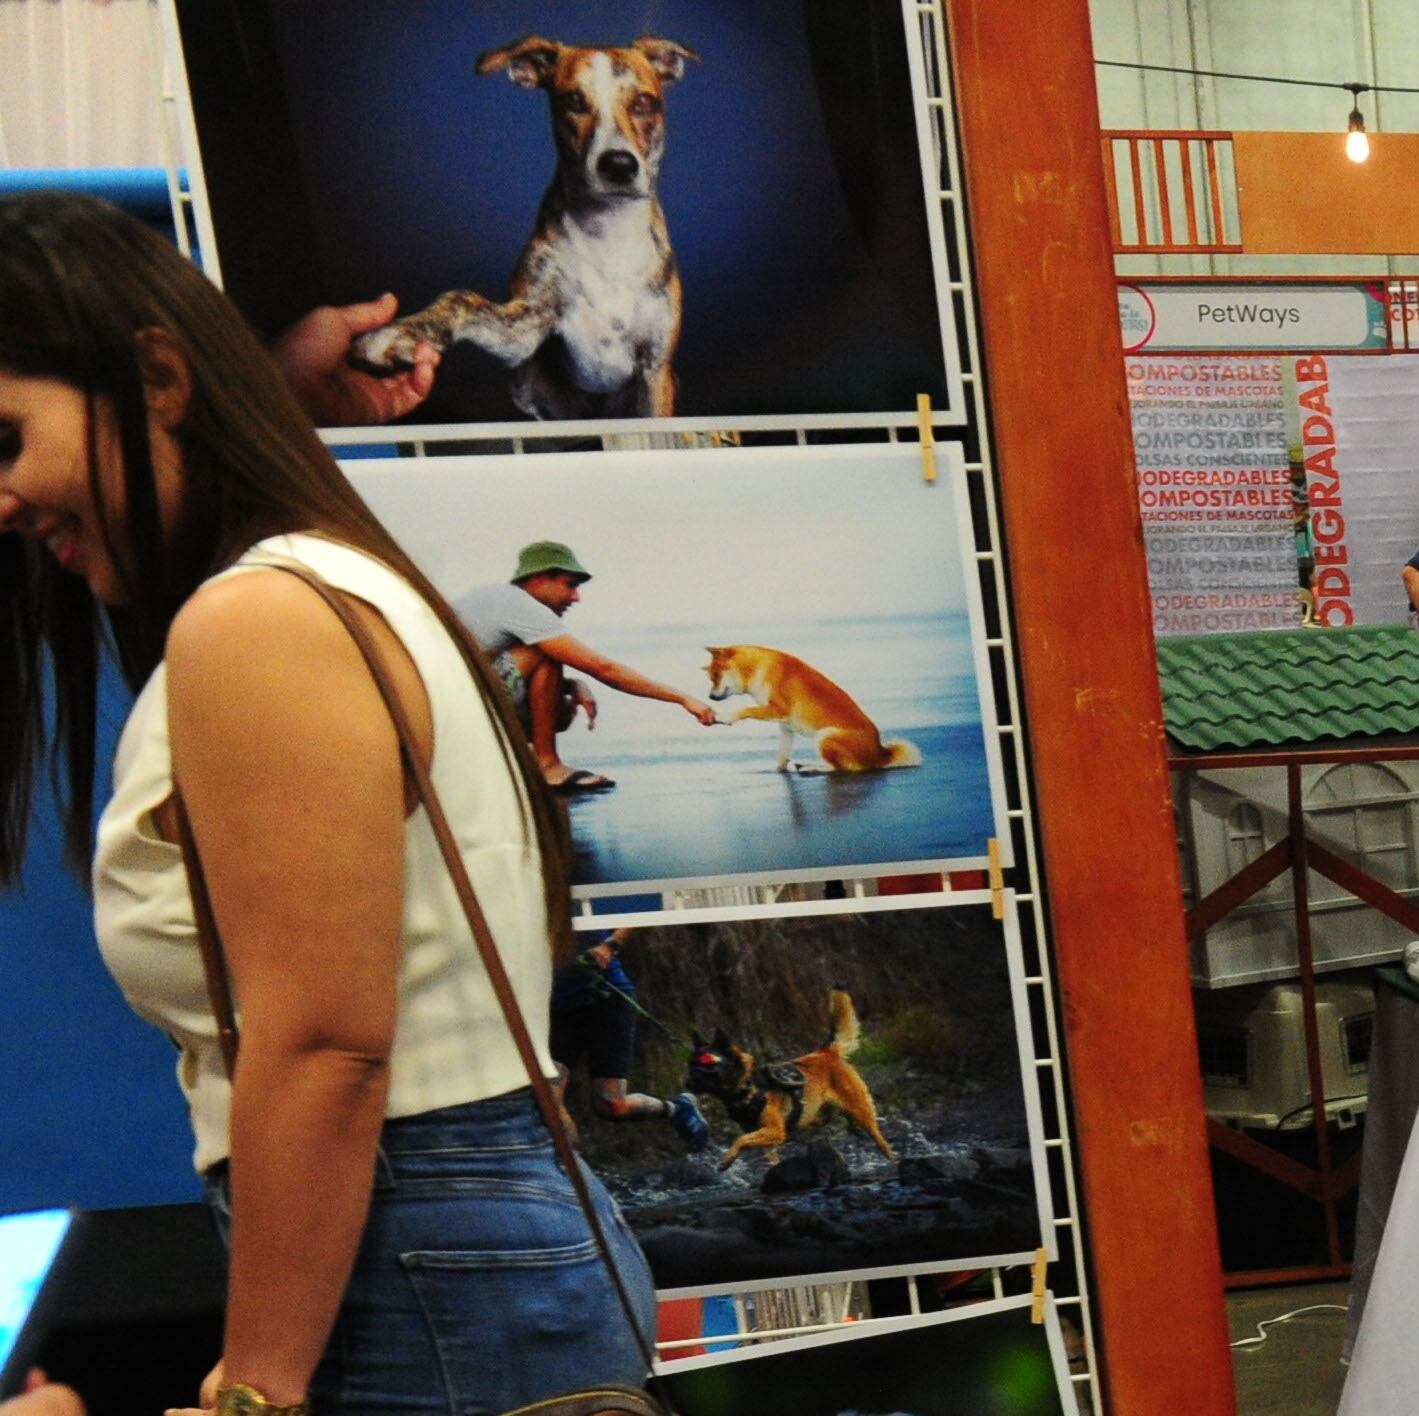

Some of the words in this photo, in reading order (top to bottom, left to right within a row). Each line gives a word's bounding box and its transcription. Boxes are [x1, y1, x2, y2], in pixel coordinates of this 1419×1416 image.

[1198, 304, 1300, 328] PetWays
[1127, 364, 1282, 382] OMPOSTABLES
[1130, 386, 1191, 397] TACIONES
[1135, 432, 1287, 449] OMPOSTABLES
[1136, 454, 1181, 466] OLSAS
[1137, 470, 1292, 487] IODEGRADABLES
[1142, 489, 1294, 507] OMPOSTABLES
[1295, 355, 1353, 627] ODEGRADAB
[1141, 511, 1201, 521] TACIONES
[1207, 511, 1222, 521] DE
[1226, 510, 1295, 521] MASCOTAS
[1150, 536, 1297, 553] ODEGRADABLES
[1150, 557, 1298, 575] OMPOSTABLES
[1155, 592, 1300, 610] ODEGRADABLES
[1156, 612, 1300, 632] OMPOSTABLES
